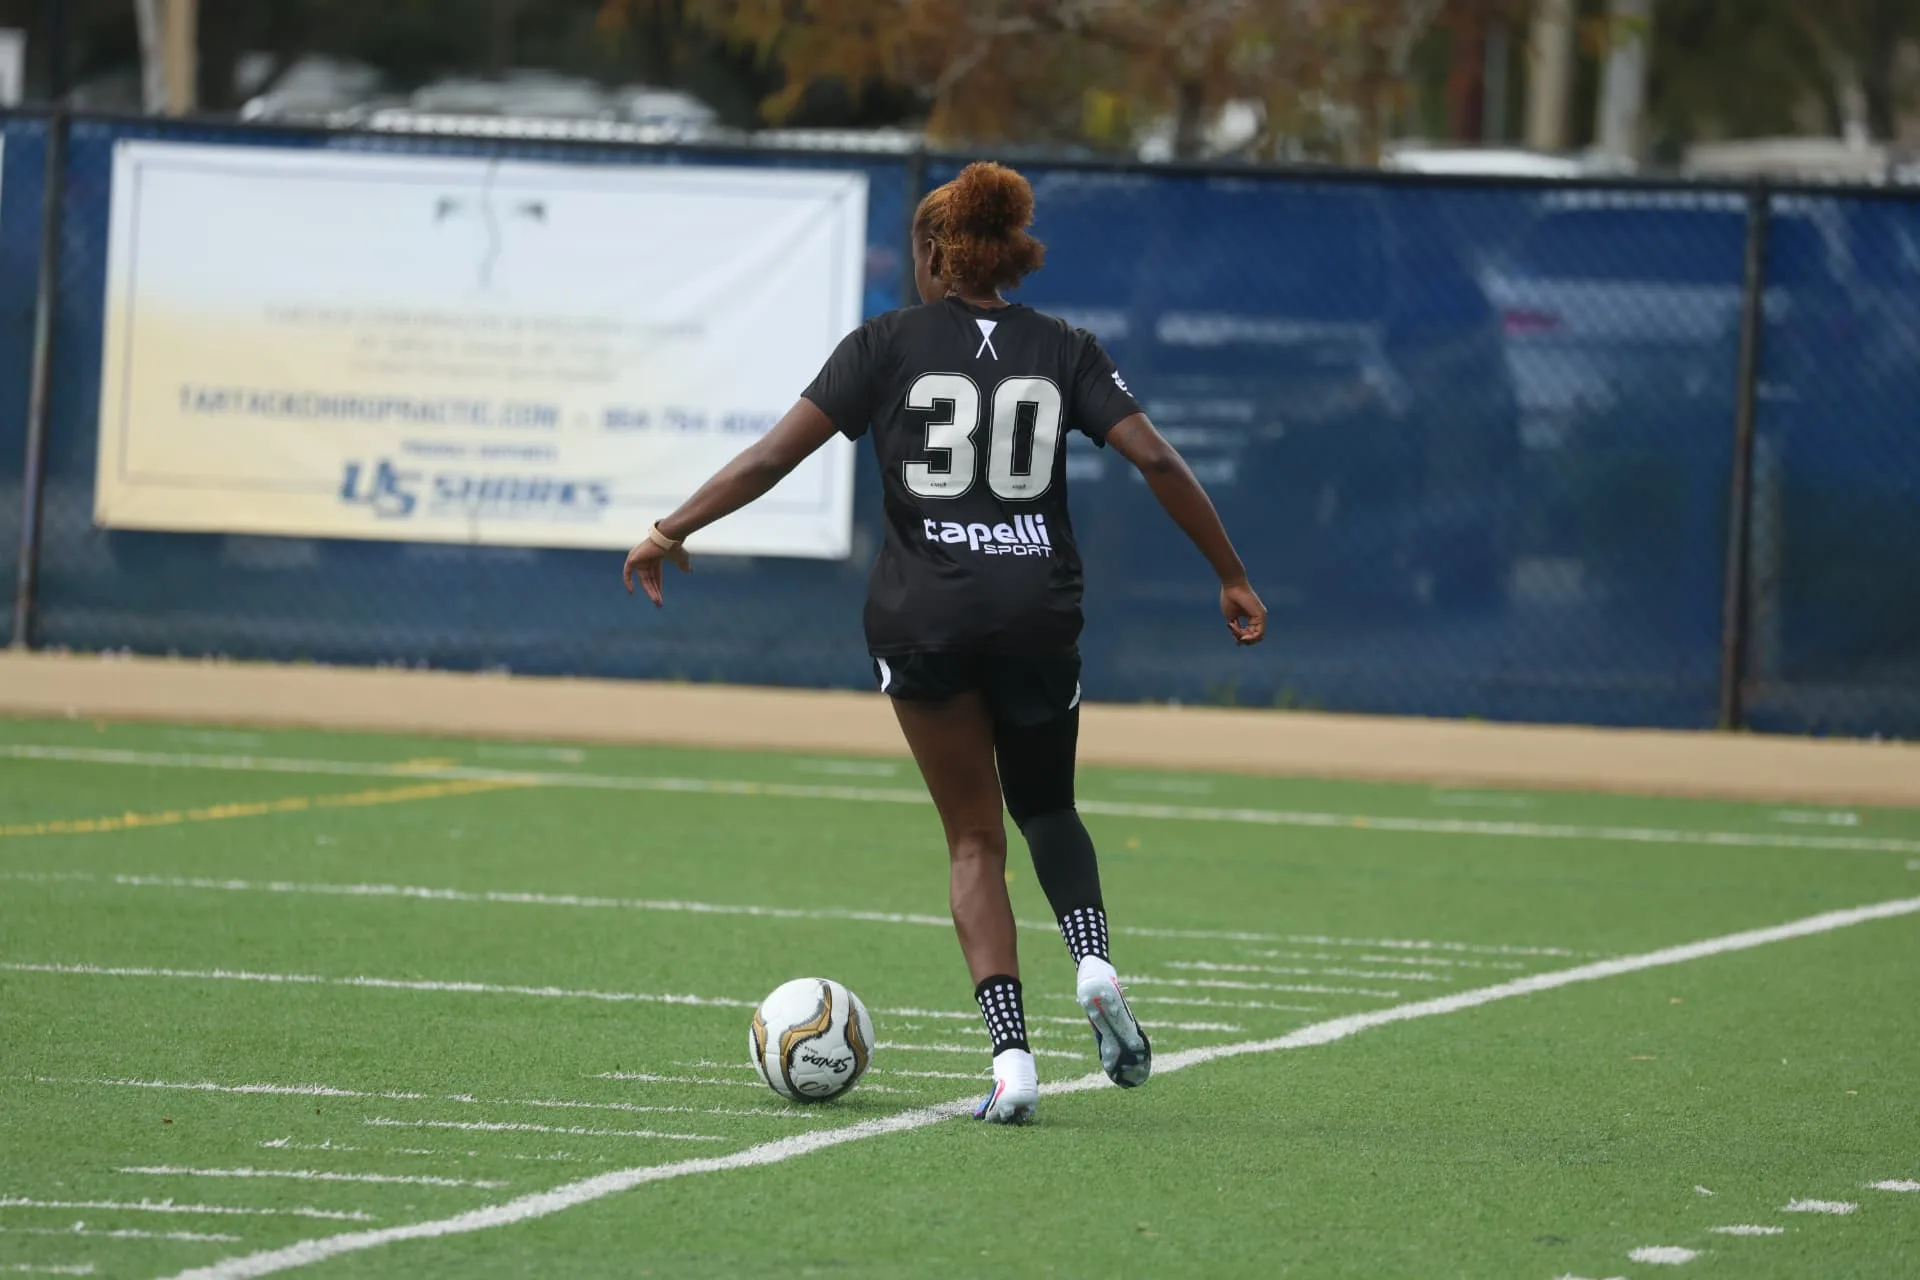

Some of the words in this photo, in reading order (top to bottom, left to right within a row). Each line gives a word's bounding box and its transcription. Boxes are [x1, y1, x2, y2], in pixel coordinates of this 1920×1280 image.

[903, 371, 1063, 502] 30
[924, 513, 1052, 551] capelli
[984, 544, 1053, 558] SPORT
[801, 1054, 852, 1074] SENDA
